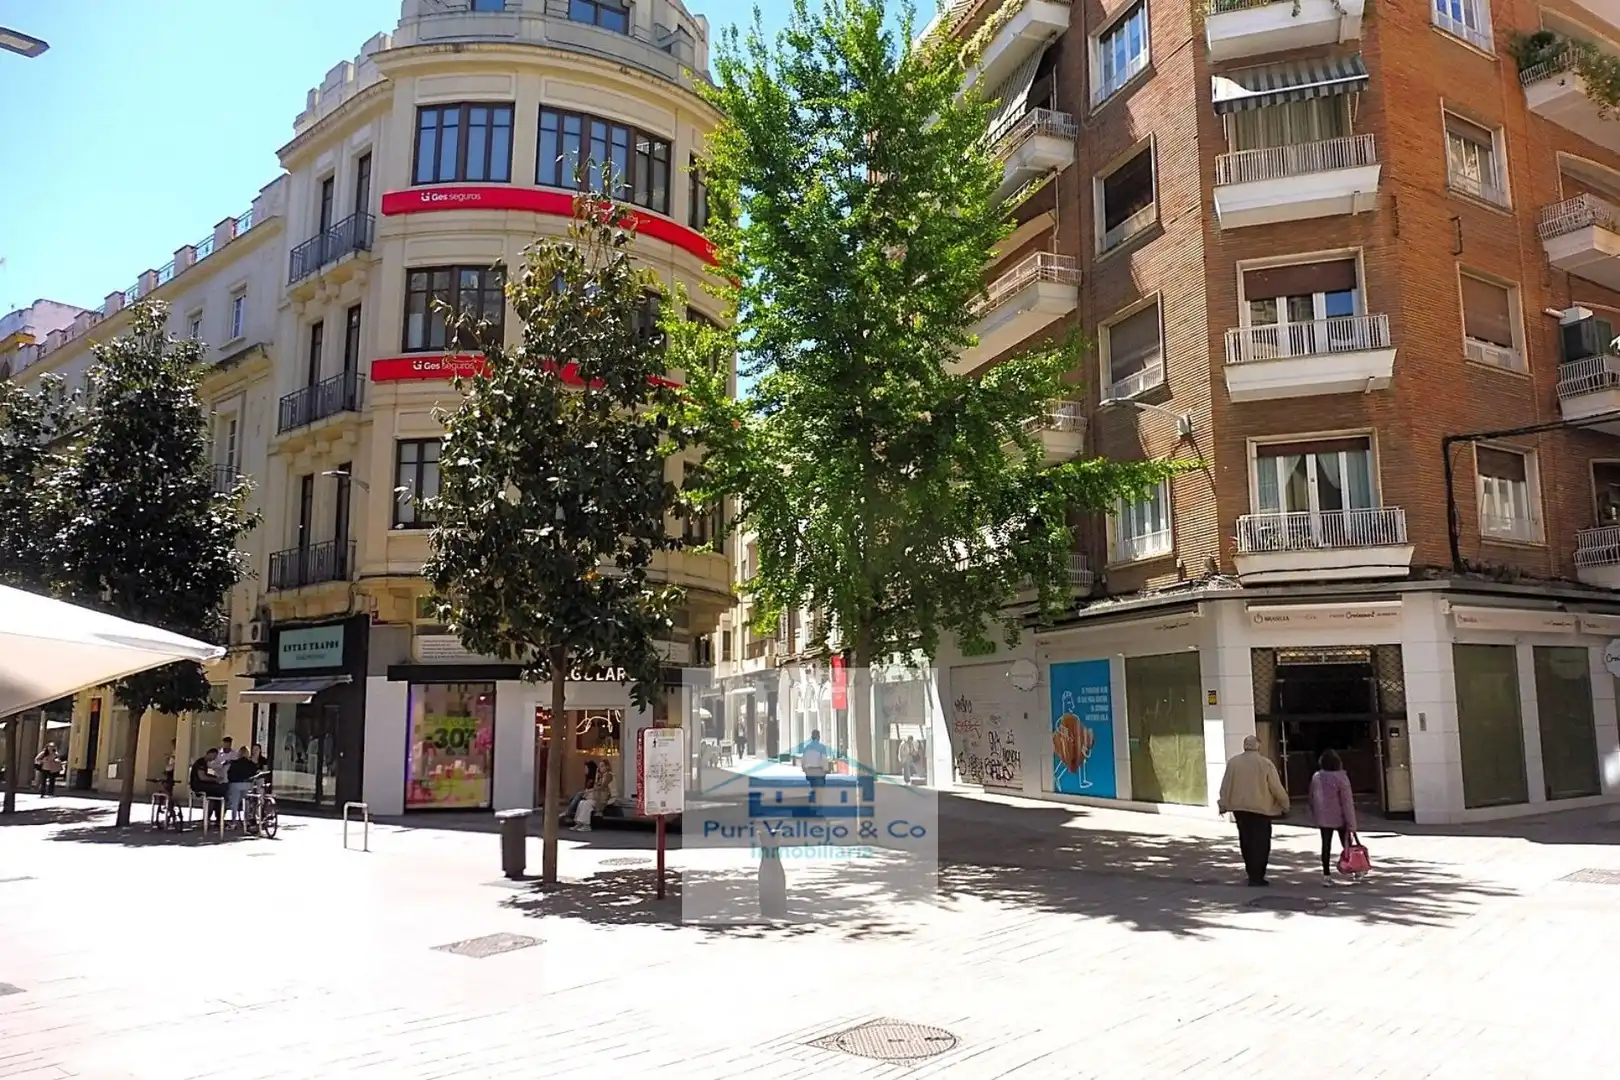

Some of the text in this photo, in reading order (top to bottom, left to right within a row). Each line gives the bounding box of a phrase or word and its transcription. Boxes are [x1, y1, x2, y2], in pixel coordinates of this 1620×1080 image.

[431, 193, 481, 202] Ges seguros
[423, 361, 440, 370] Ges
